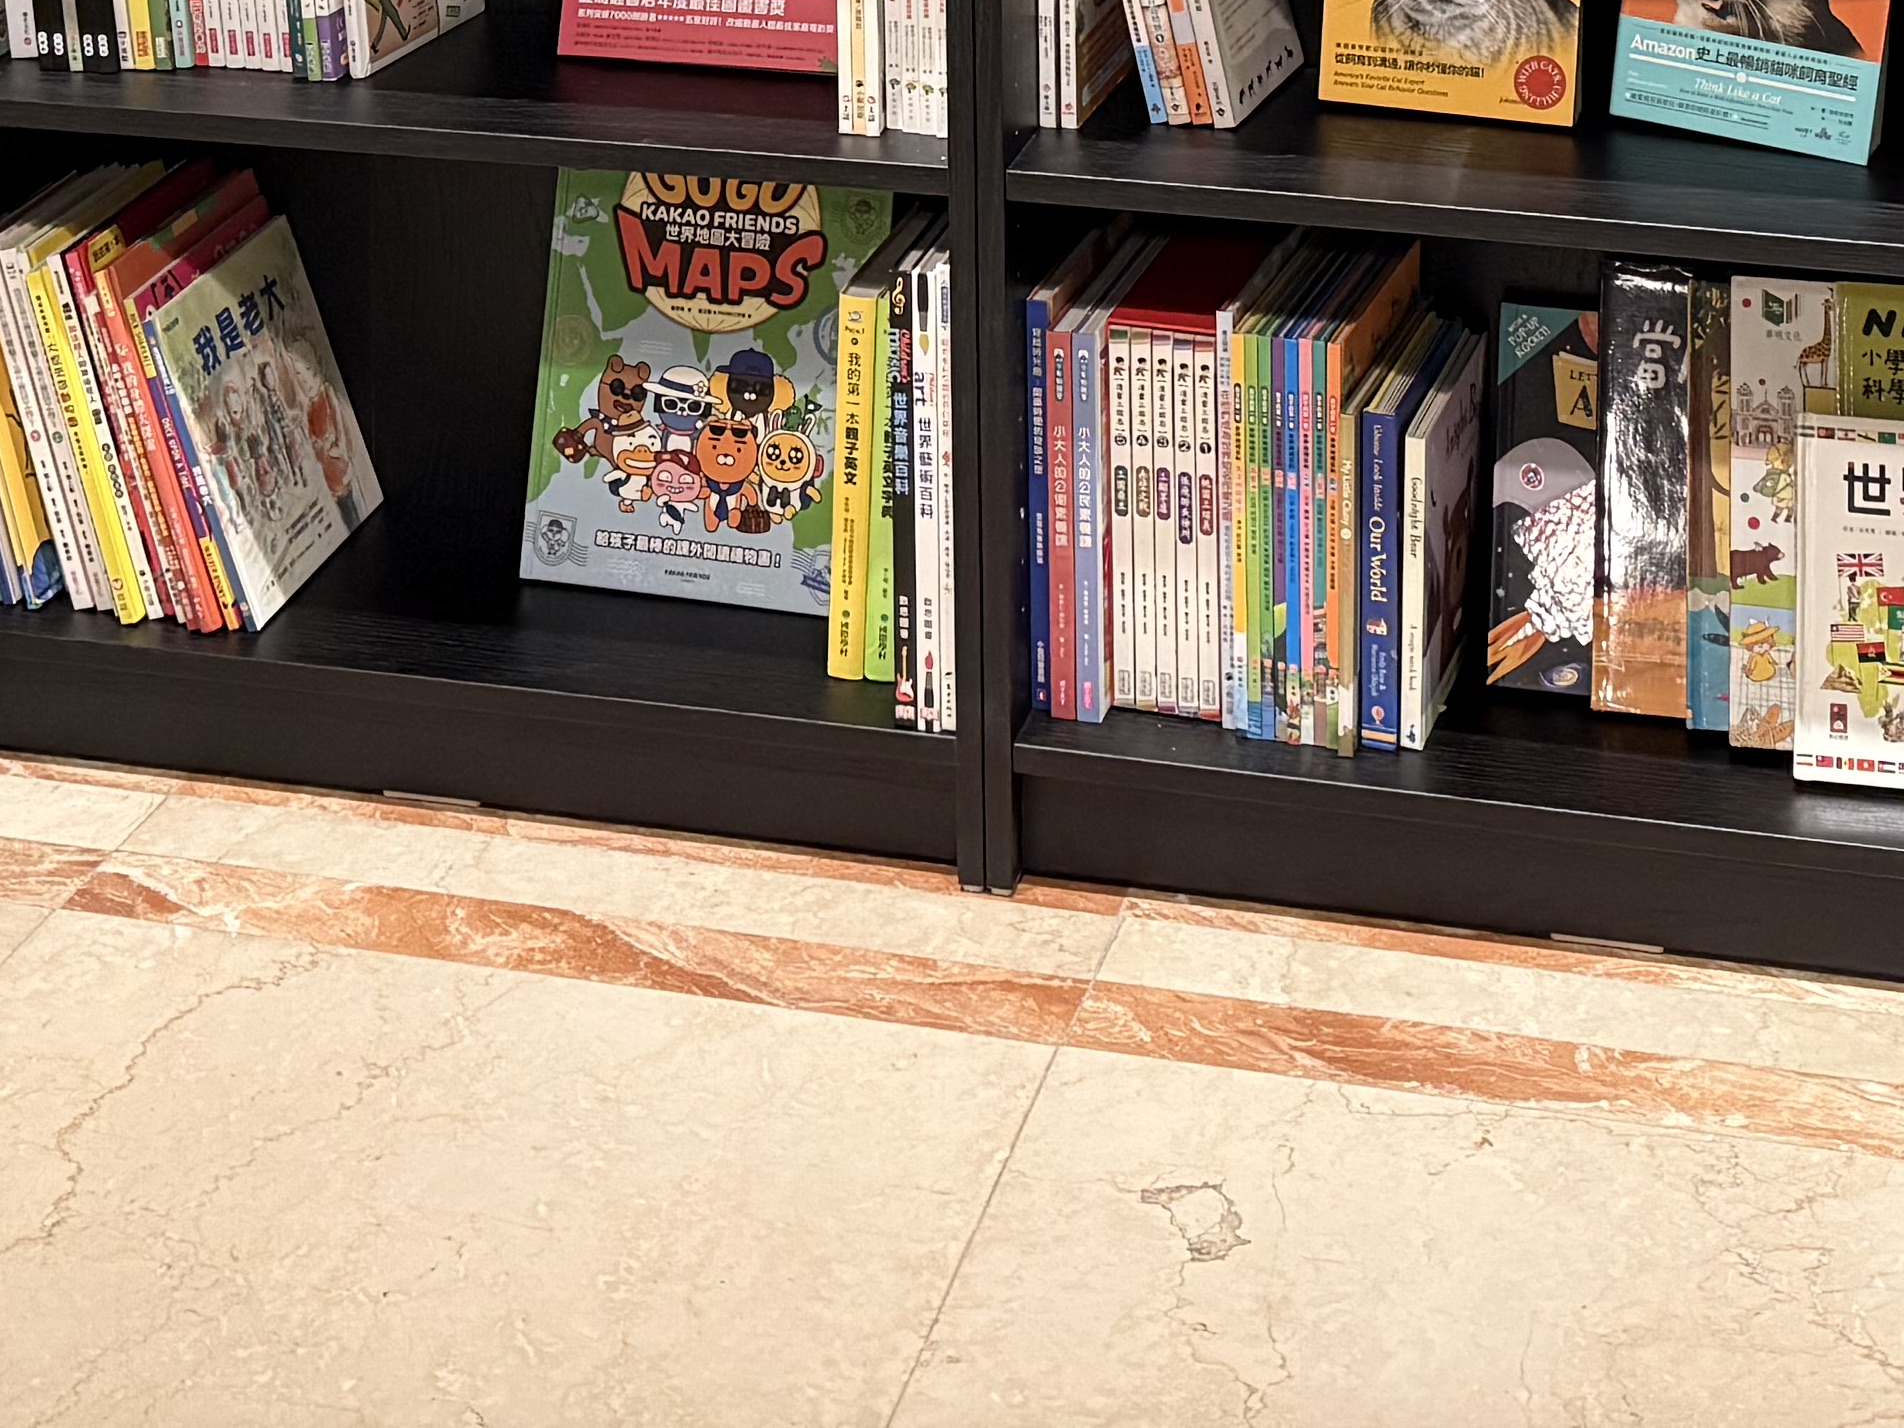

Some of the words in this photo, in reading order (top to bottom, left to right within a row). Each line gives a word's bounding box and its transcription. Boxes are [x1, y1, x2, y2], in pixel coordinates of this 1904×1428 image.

[1630, 34, 1696, 60] Amazon
[641, 204, 709, 226] KAKAO
[713, 210, 799, 235] FRIENDS
[666, 225, 771, 250] 世界地圖大冒險
[619, 208, 826, 305] MAPS
[193, 274, 286, 376] 我是老大
[918, 418, 934, 520] 世界藝術百科
[1370, 515, 1387, 545] Our
[1370, 550, 1387, 602] World
